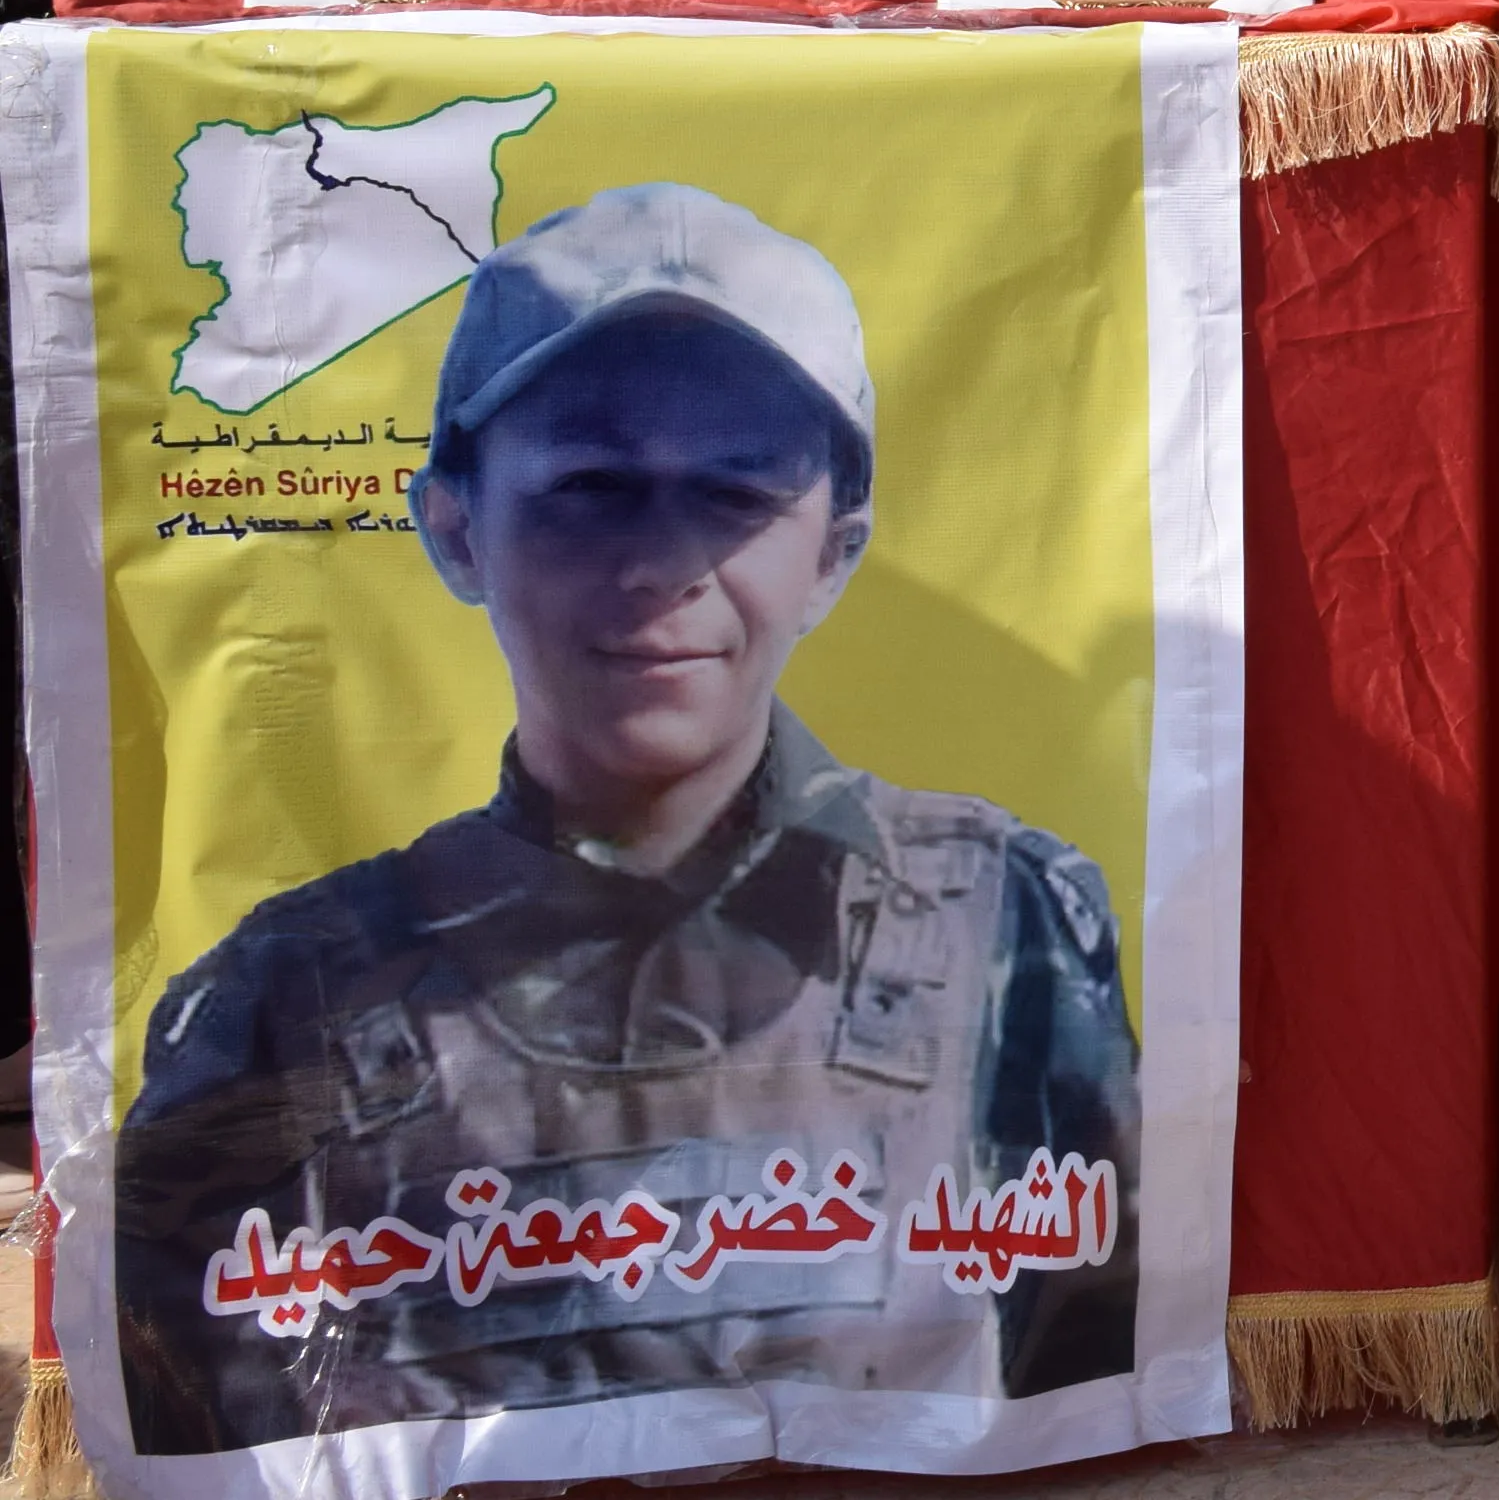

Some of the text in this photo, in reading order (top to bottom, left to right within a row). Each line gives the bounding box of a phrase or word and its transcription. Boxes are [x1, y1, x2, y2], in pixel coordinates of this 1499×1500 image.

[151, 421, 374, 454] الديمقراطية
[160, 468, 266, 498] Hêzên
[277, 468, 381, 503] Sûriya
[210, 1152, 1109, 1333] الشهيد خضر جمعة حميد
